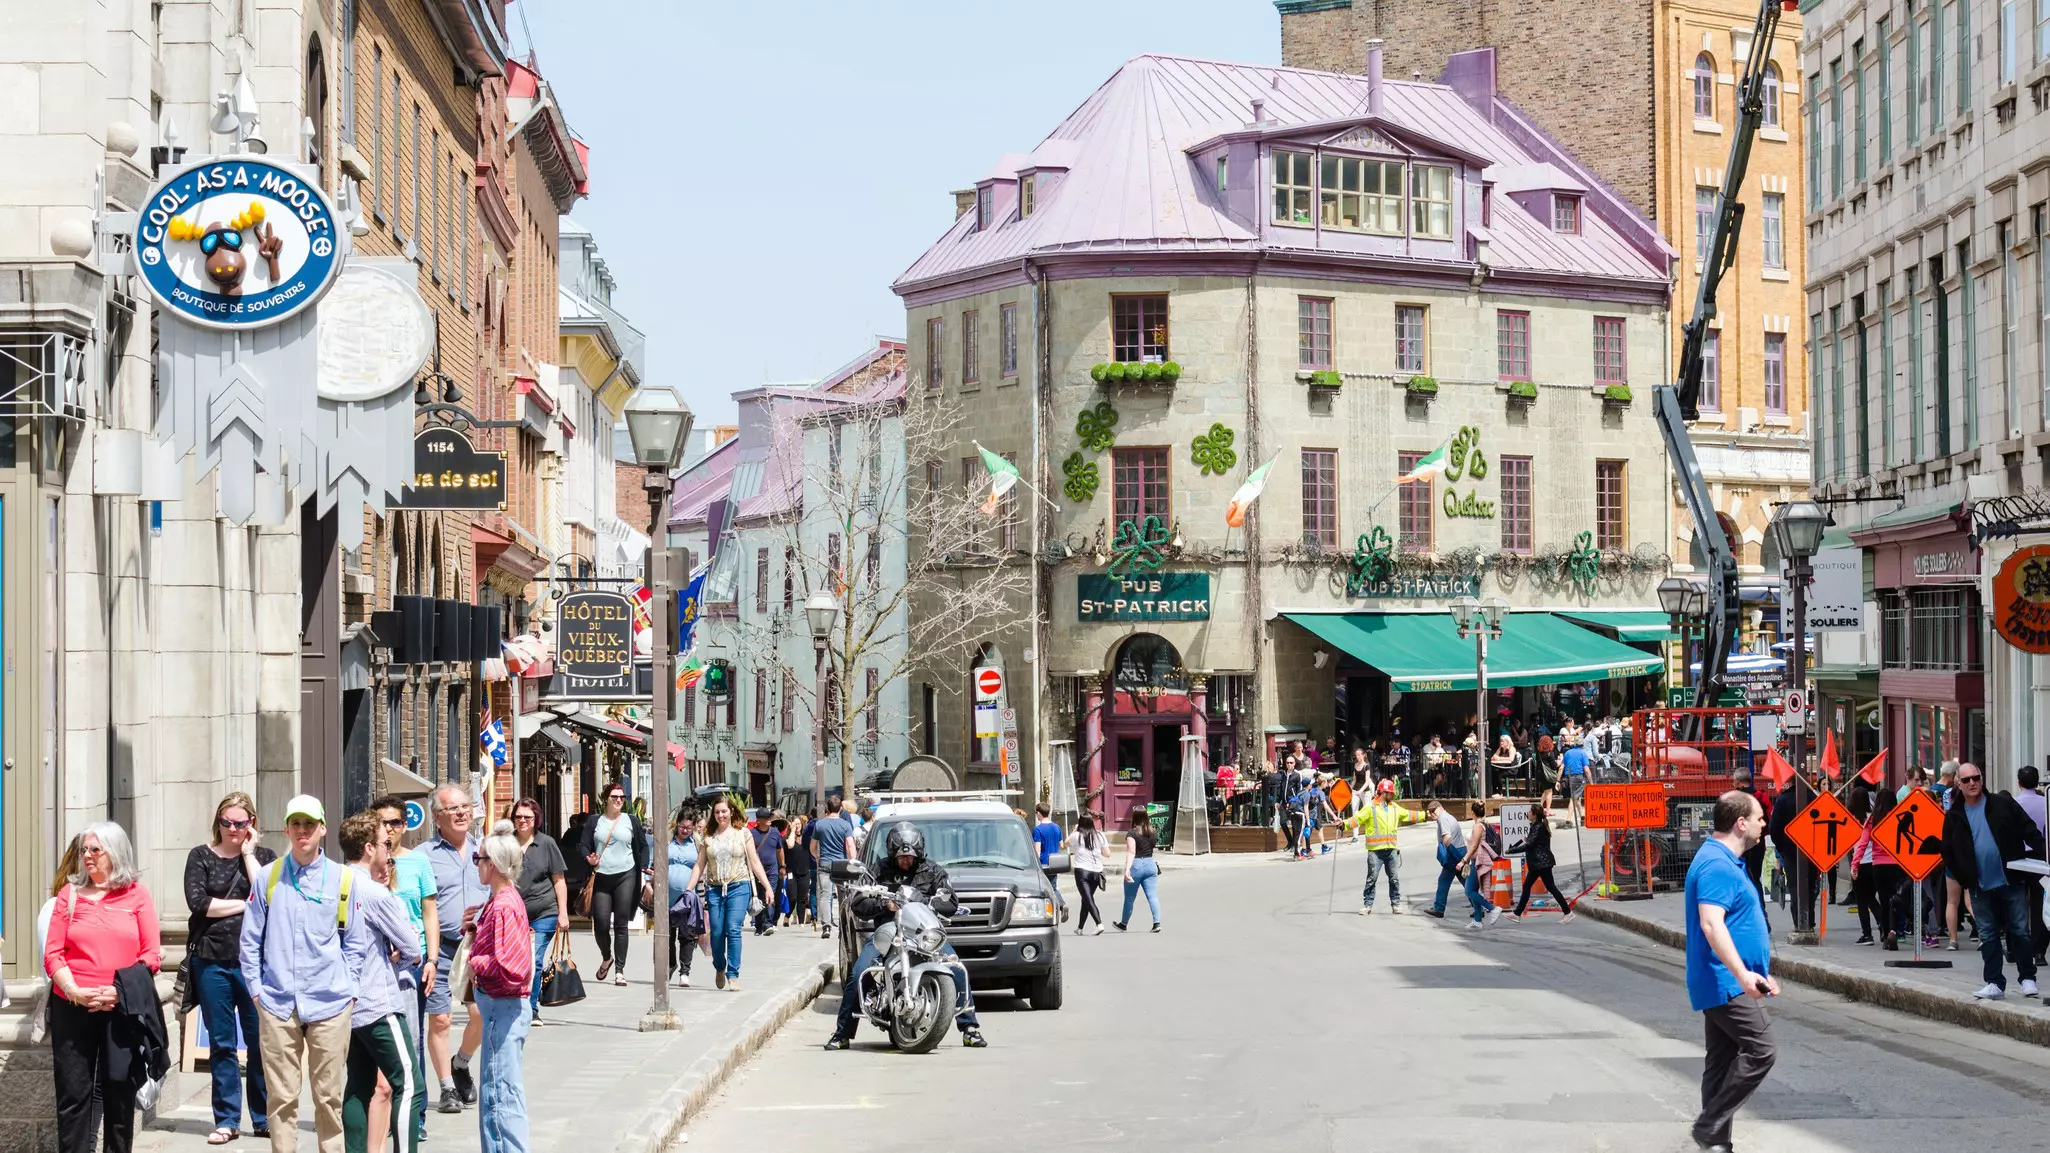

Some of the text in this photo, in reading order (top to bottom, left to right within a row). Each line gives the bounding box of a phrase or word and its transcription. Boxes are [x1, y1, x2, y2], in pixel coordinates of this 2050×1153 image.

[143, 189, 190, 242] COOL
[259, 171, 328, 234] MOOSE
[172, 281, 306, 313] BOUTIQUE DE SOUVENIRS
[427, 442, 455, 453] 1154
[440, 470, 464, 487] de
[469, 470, 498, 487] soi
[1813, 562, 1857, 570] BOUTIQUE
[1121, 580, 1162, 593] PUB
[564, 601, 628, 620] HÔTEL
[589, 622, 601, 630] DU
[1810, 618, 1859, 628] SOULIERS
[568, 632, 624, 646] VIEUX-
[561, 646, 628, 665] QUÉBEC
[1589, 790, 1624, 799] UTILISER
[1628, 791, 1664, 803] TROTTOIR
[1508, 811, 1529, 820] LIGN
[1590, 814, 1625, 823] TROTTOIR
[1504, 826, 1529, 836] D'ARR
